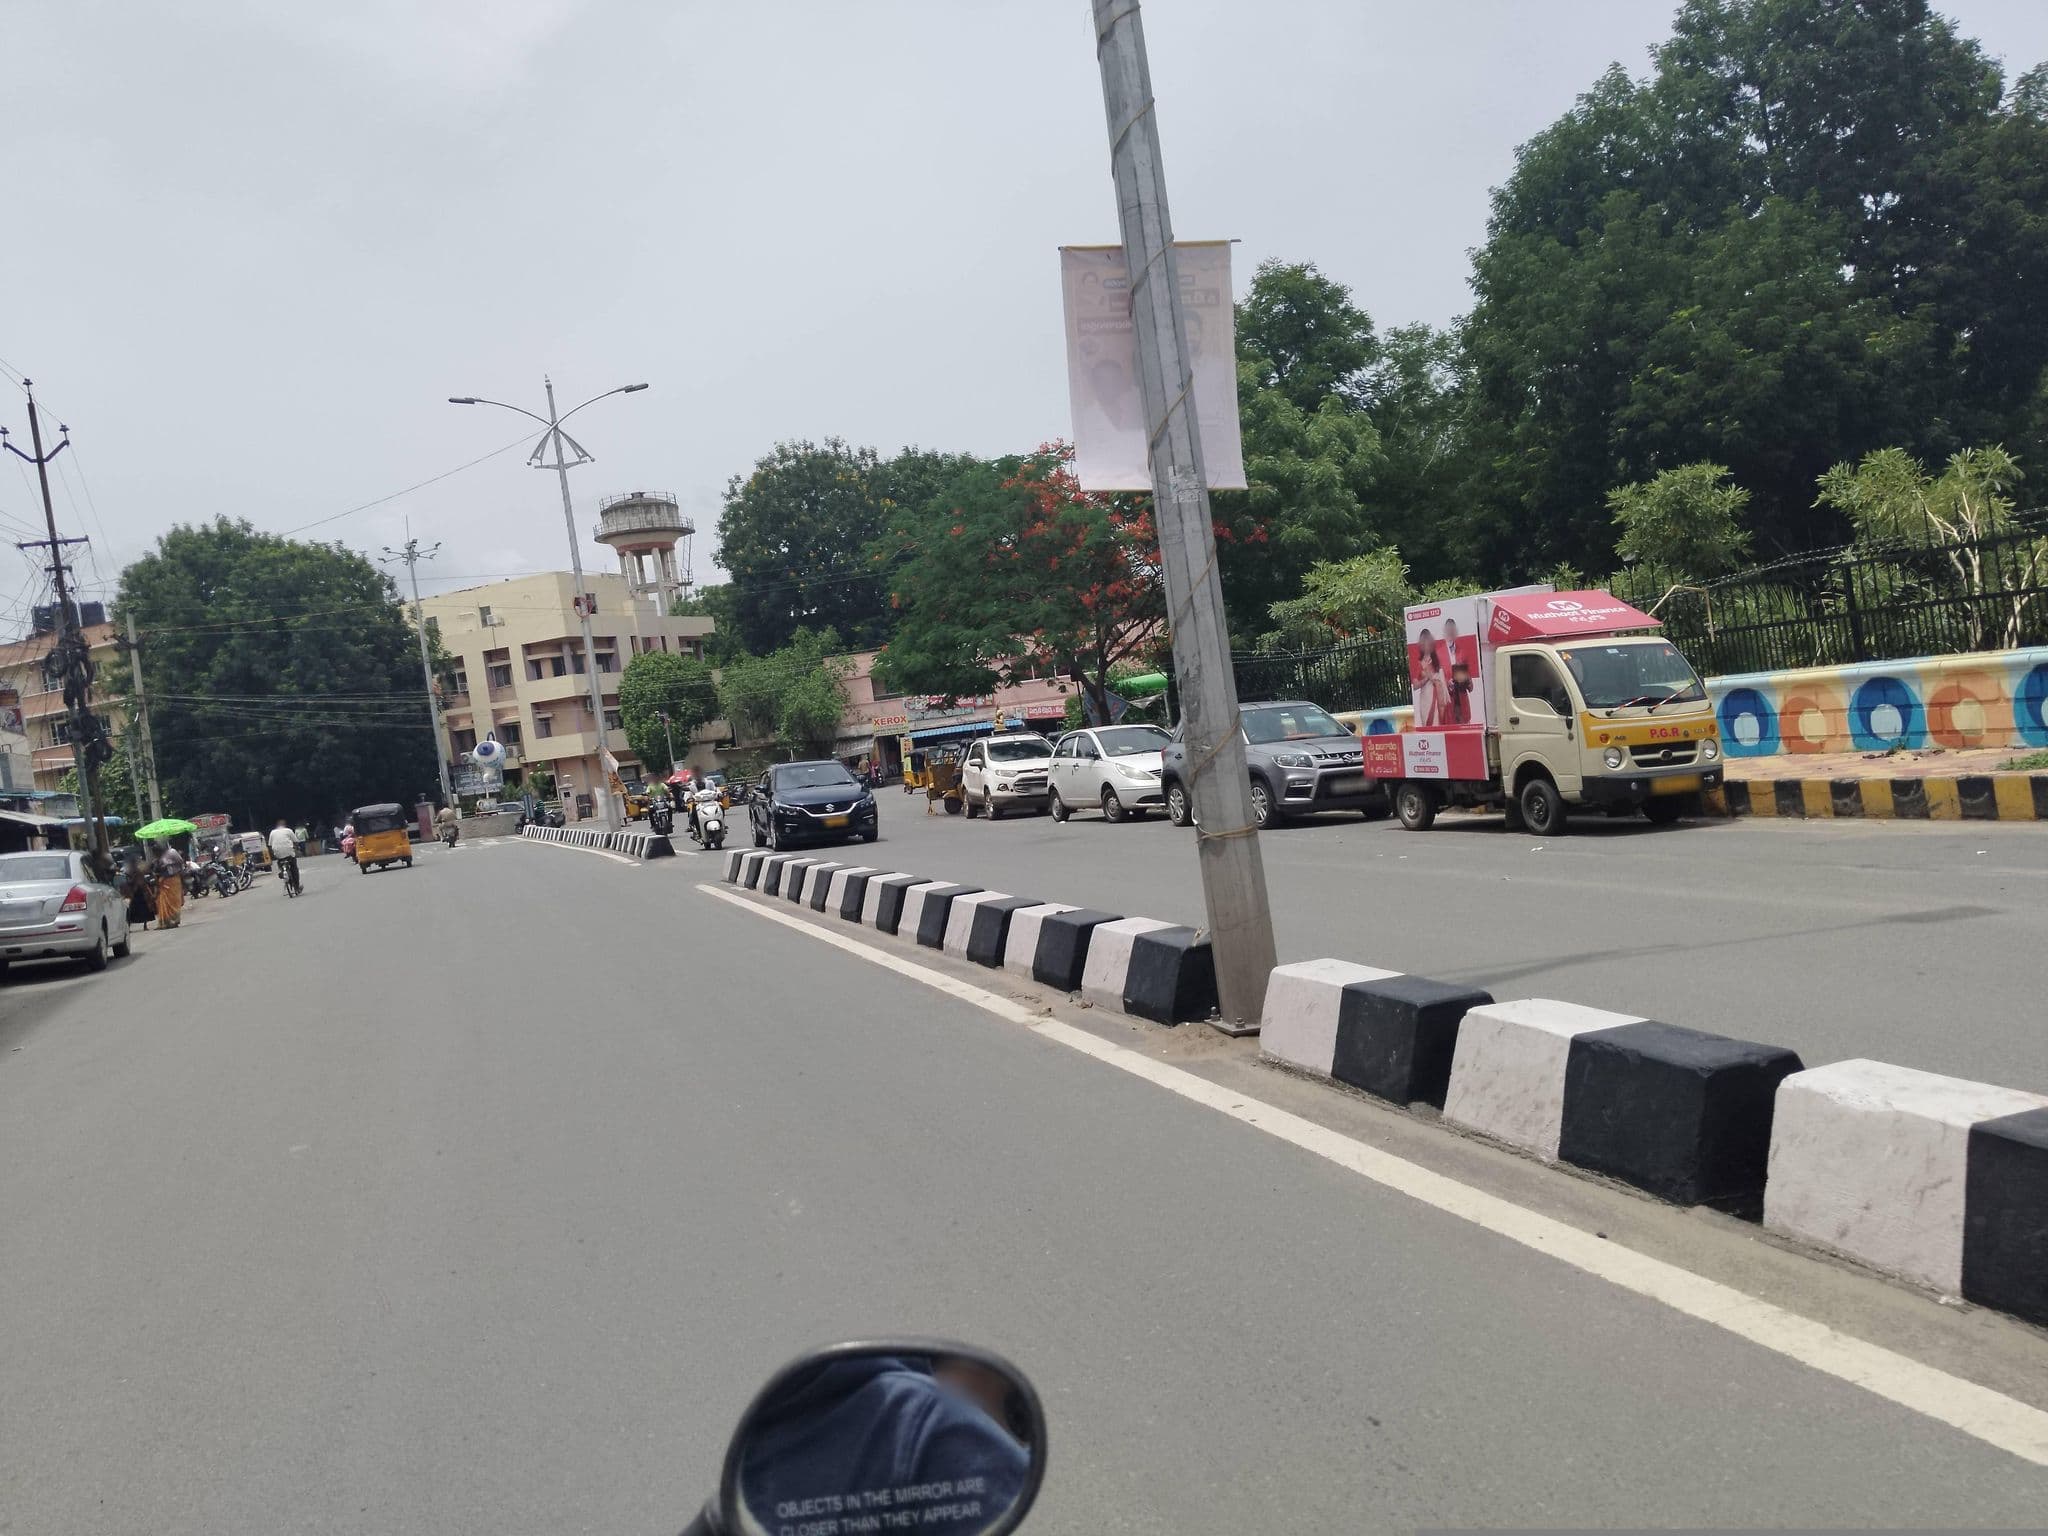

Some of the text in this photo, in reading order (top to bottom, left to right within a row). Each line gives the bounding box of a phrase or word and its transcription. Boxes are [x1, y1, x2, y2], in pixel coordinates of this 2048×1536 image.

[1581, 606, 1628, 615] Finance
[874, 715, 907, 726] XEROX
[776, 1476, 985, 1518] OBJECTS IN THE MIRROR ARE
[780, 1501, 982, 1536] CLOSER THAN THEY APPEAR
